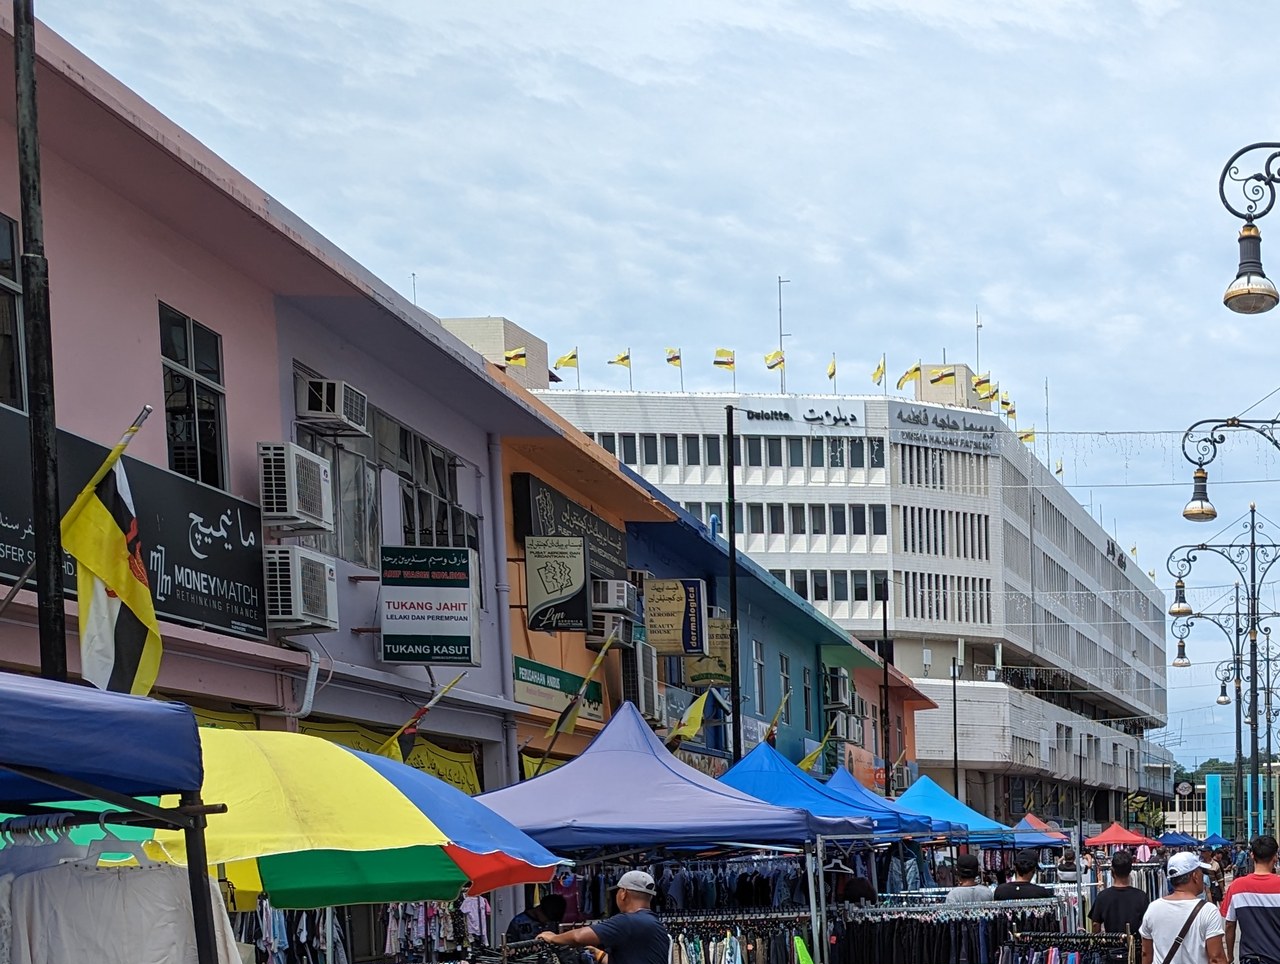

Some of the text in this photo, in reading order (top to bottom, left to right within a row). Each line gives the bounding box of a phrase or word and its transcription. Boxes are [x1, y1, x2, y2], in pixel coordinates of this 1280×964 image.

[747, 410, 793, 421] Deloitte.
[174, 564, 259, 607] MONEYMATCH
[176, 589, 258, 620] RETHINKING FINANCE
[385, 601, 468, 611] TUKANG JAHIT
[687, 586, 697, 647] dermalogica
[385, 644, 469, 654] TUKANG KASUT
